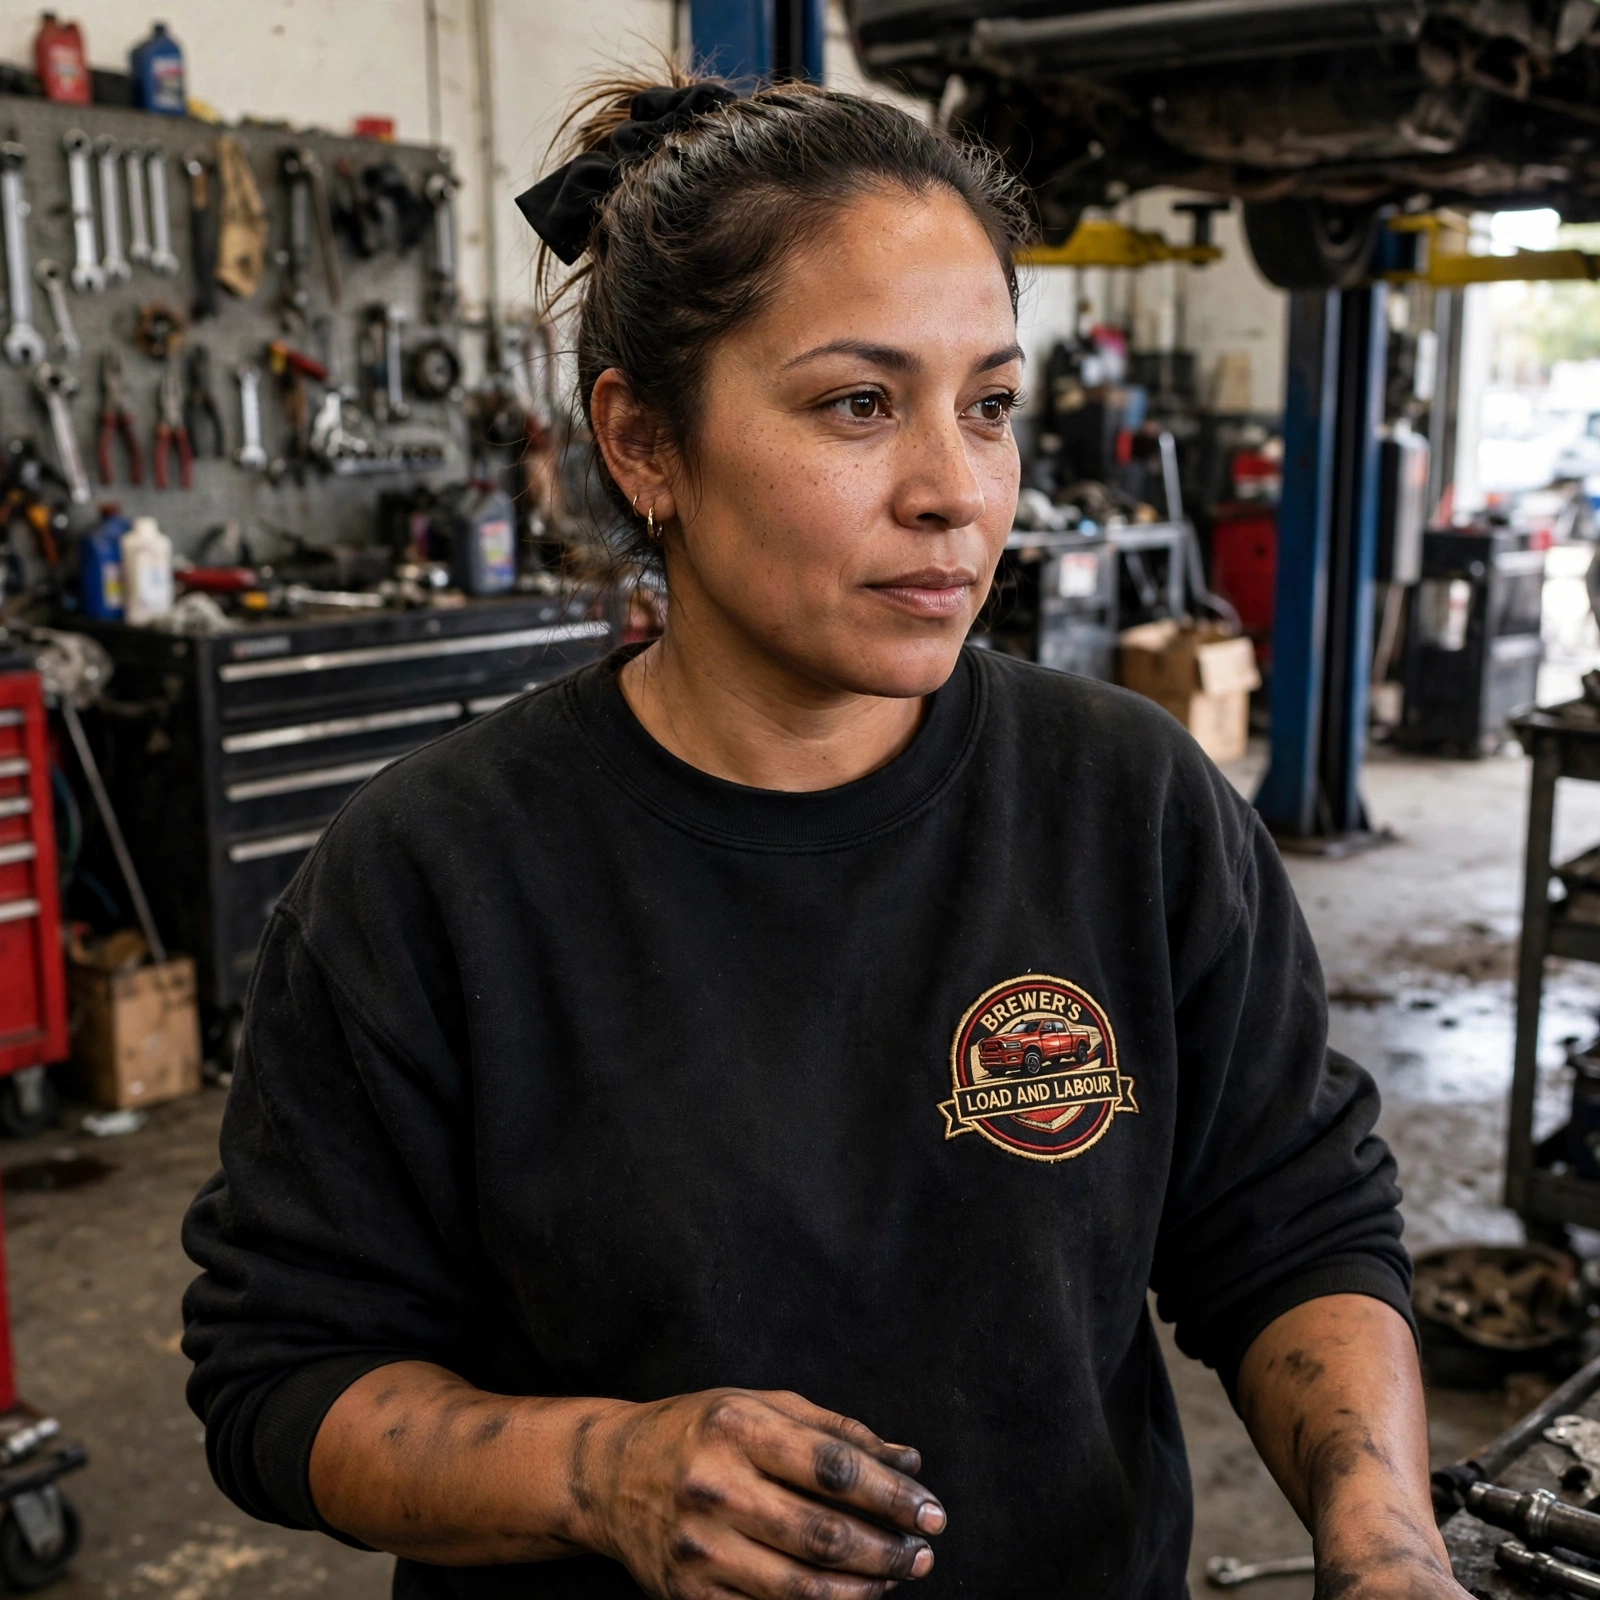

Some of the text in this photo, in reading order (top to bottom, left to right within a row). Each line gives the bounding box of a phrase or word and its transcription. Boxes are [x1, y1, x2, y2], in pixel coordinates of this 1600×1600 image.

[980, 991, 1082, 1032] BREWER'S
[966, 1076, 1112, 1111] LOAD AND LABOUR
